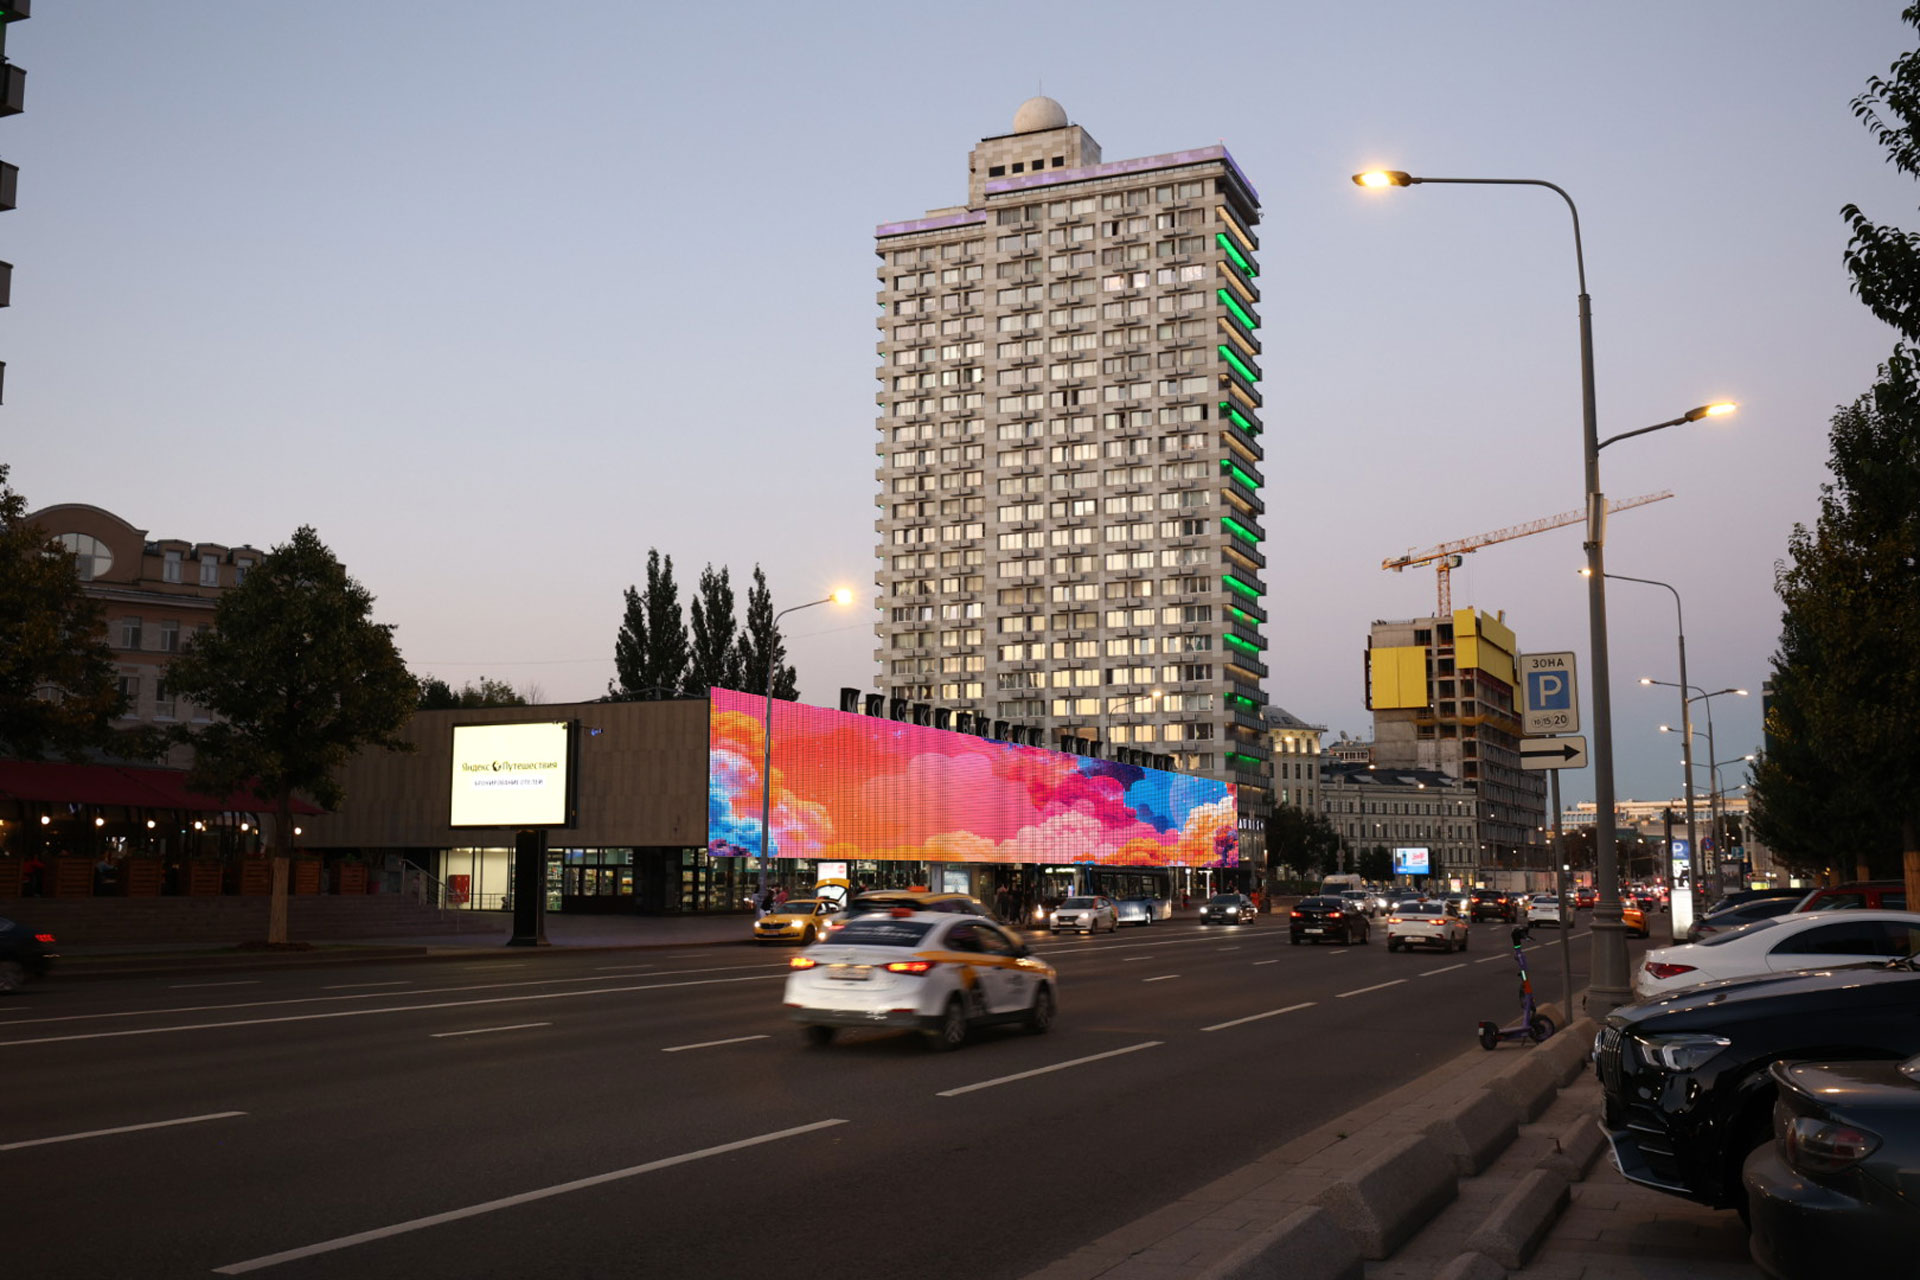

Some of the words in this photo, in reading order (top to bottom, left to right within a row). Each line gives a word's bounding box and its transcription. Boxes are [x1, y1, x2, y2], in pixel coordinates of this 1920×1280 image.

[1532, 658, 1564, 668] ЗОНА
[1539, 675, 1562, 707] P
[1543, 717, 1551, 725] 15
[1554, 715, 1567, 724] 20
[462, 762, 490, 772] Яндекс
[502, 761, 558, 772] Путешествия
